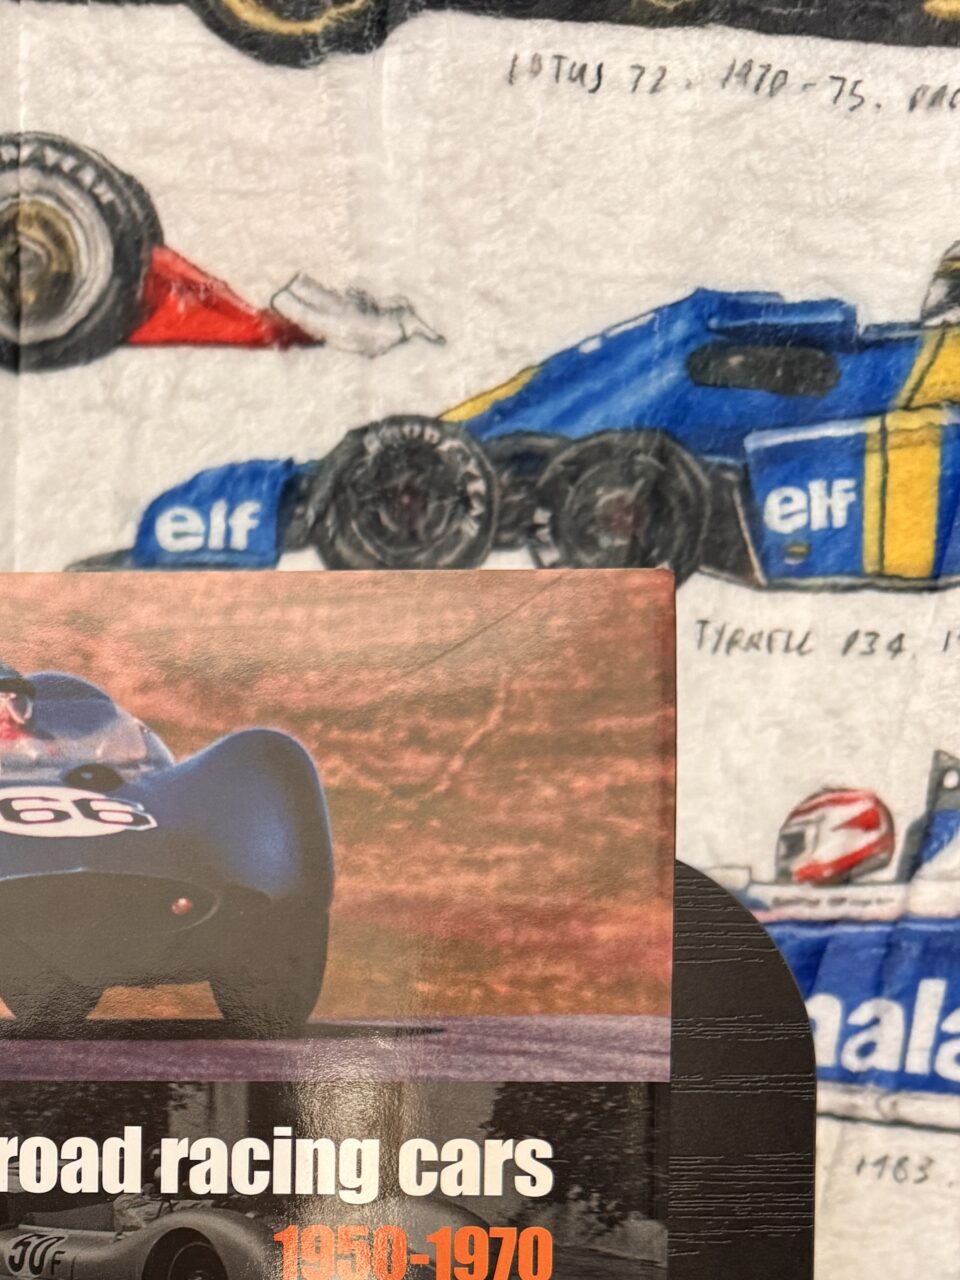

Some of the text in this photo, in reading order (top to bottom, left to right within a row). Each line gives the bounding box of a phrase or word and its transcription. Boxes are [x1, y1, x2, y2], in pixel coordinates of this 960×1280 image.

[154, 498, 261, 552] elf
[763, 478, 857, 535] elf
[159, 1125, 380, 1205] racing
[397, 1137, 555, 1197] cars
